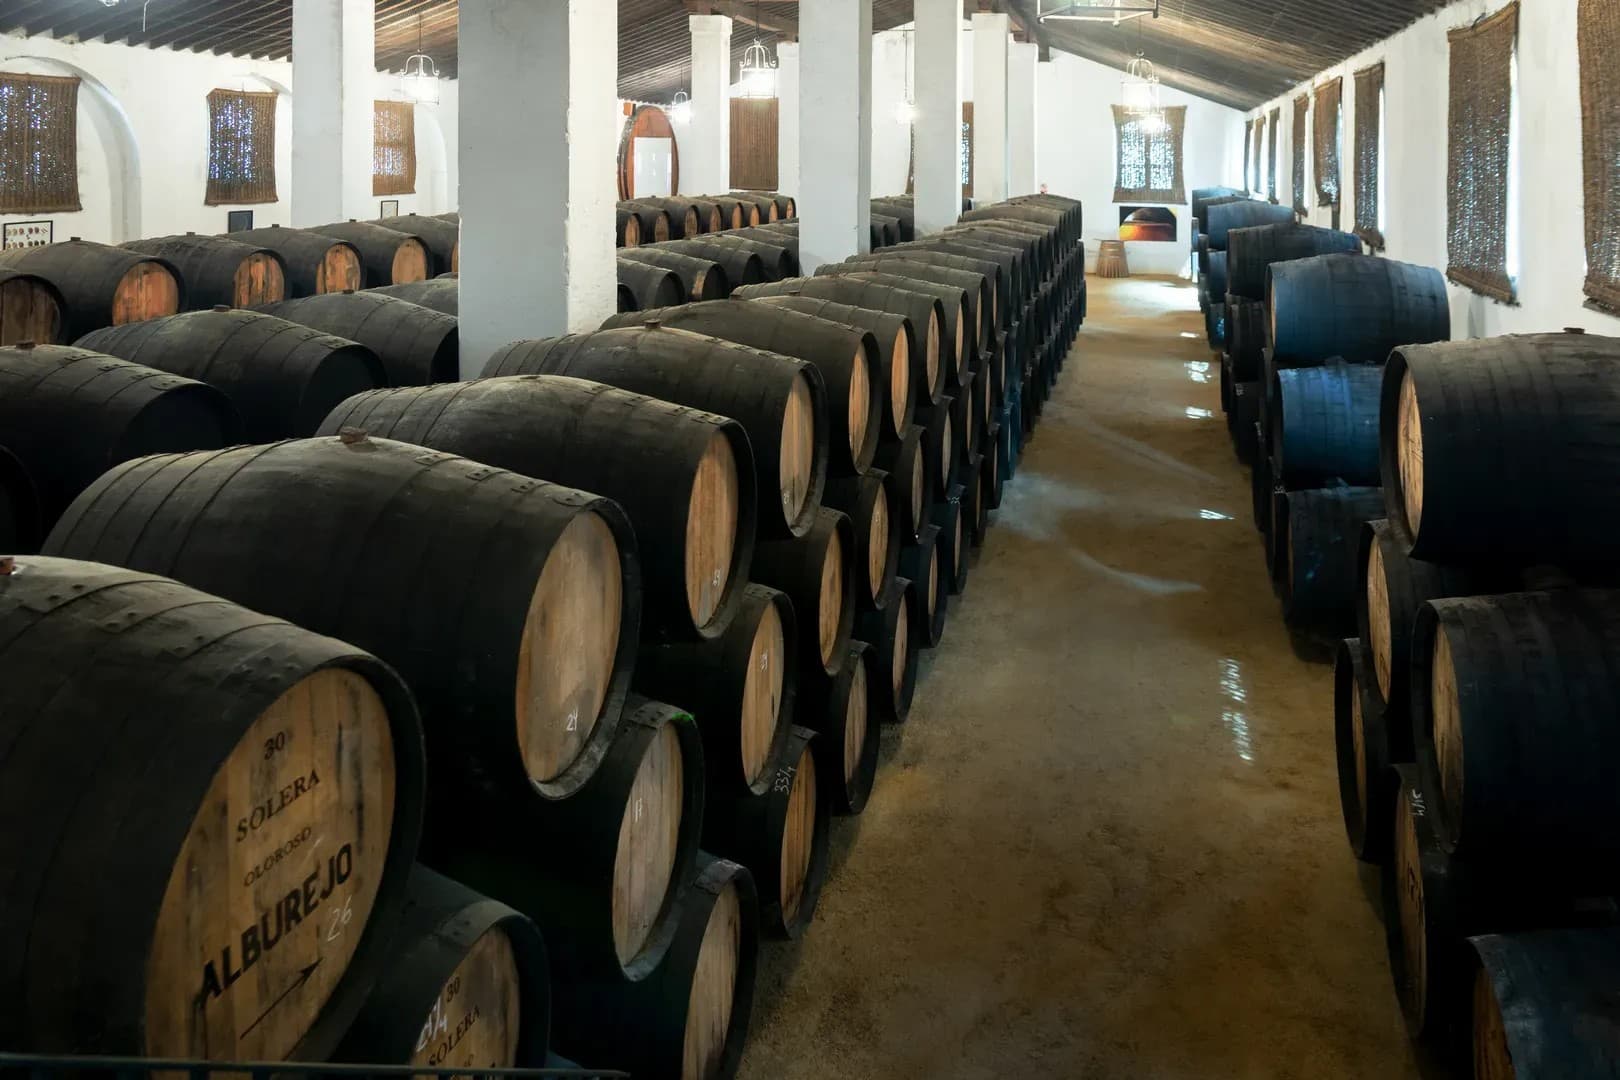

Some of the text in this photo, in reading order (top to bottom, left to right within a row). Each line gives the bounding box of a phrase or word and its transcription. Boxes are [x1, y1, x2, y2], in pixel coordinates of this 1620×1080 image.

[263, 731, 286, 761] 30
[236, 768, 321, 843] SOLERA
[244, 826, 312, 887] OLOROSO
[200, 842, 353, 1003] ALBUREJO
[327, 894, 353, 942] 26
[446, 976, 460, 1004] 30
[428, 1003, 481, 1067] SOLERA
